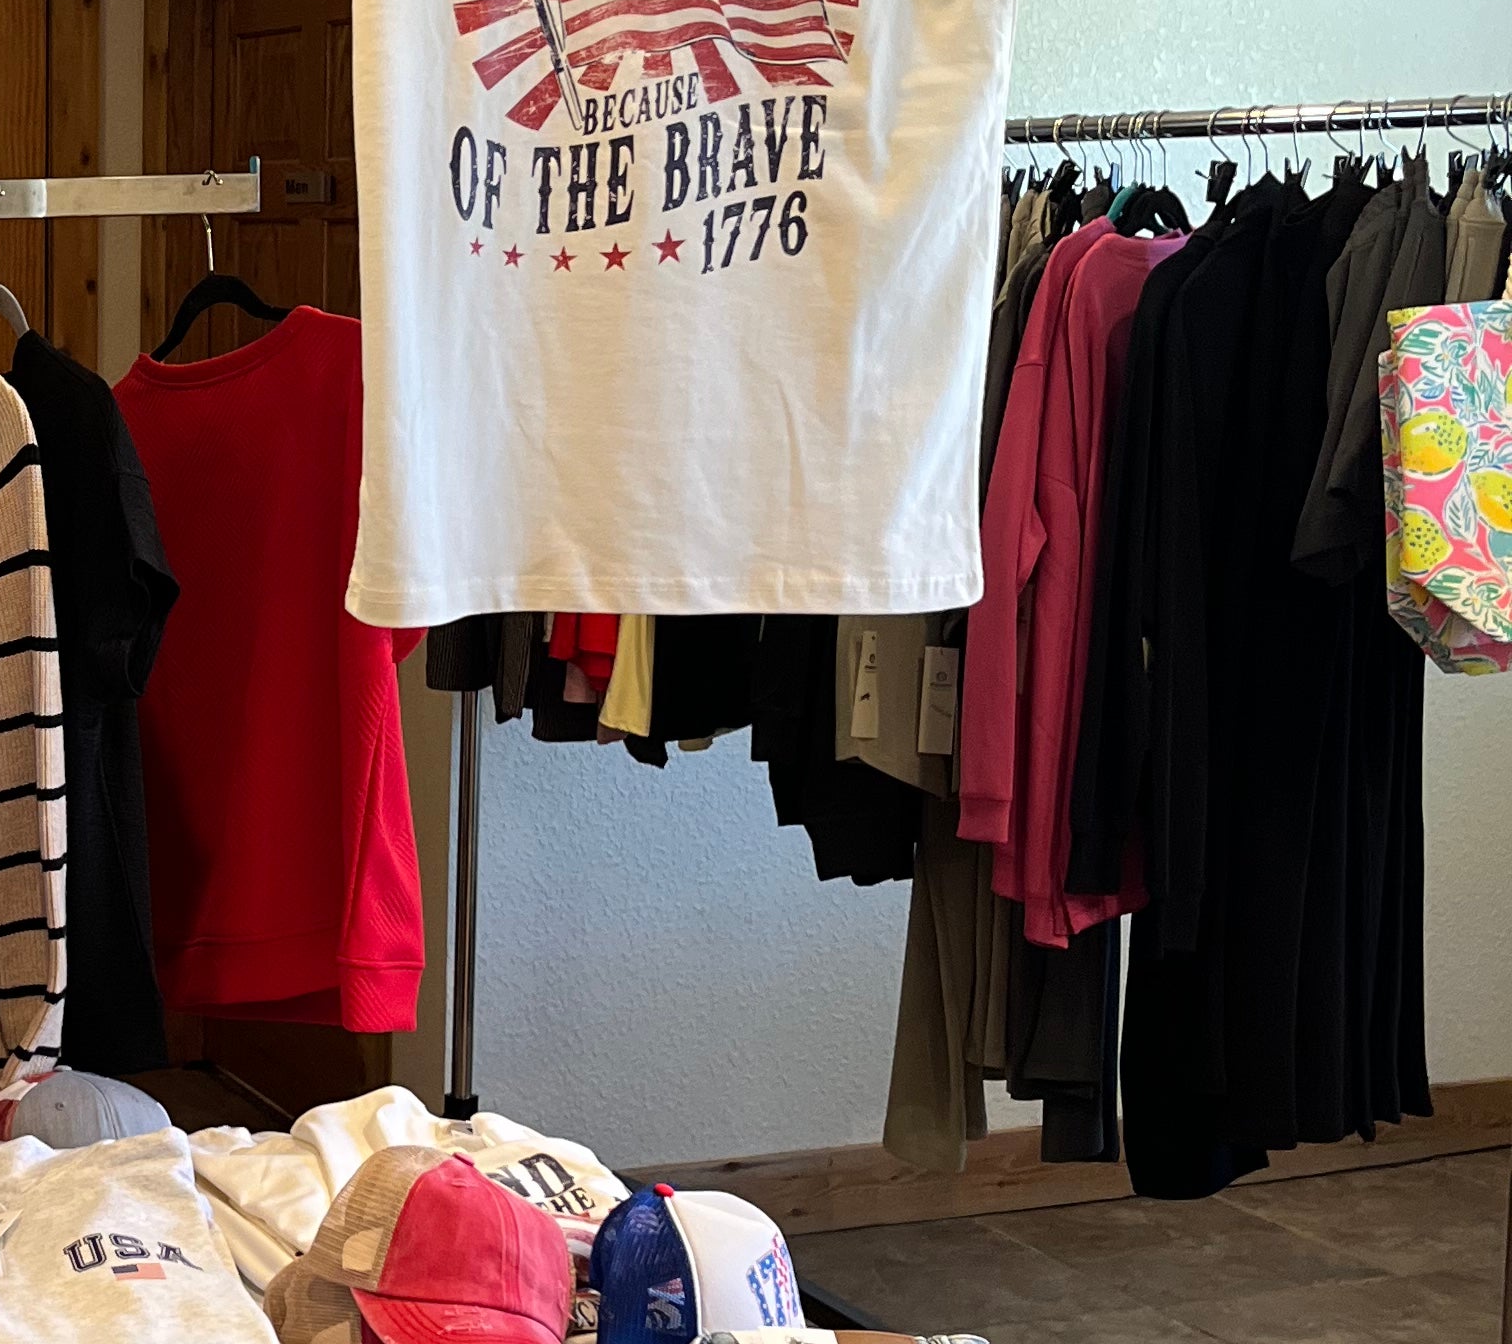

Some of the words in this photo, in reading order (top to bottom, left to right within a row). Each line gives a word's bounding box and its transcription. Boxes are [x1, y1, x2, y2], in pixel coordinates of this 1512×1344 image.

[582, 71, 701, 136] BECAUSE
[448, 125, 508, 231] OF
[531, 134, 636, 236] THE
[662, 94, 828, 214] BRAVE
[701, 189, 808, 275] 1776
[62, 1232, 205, 1273] USA
